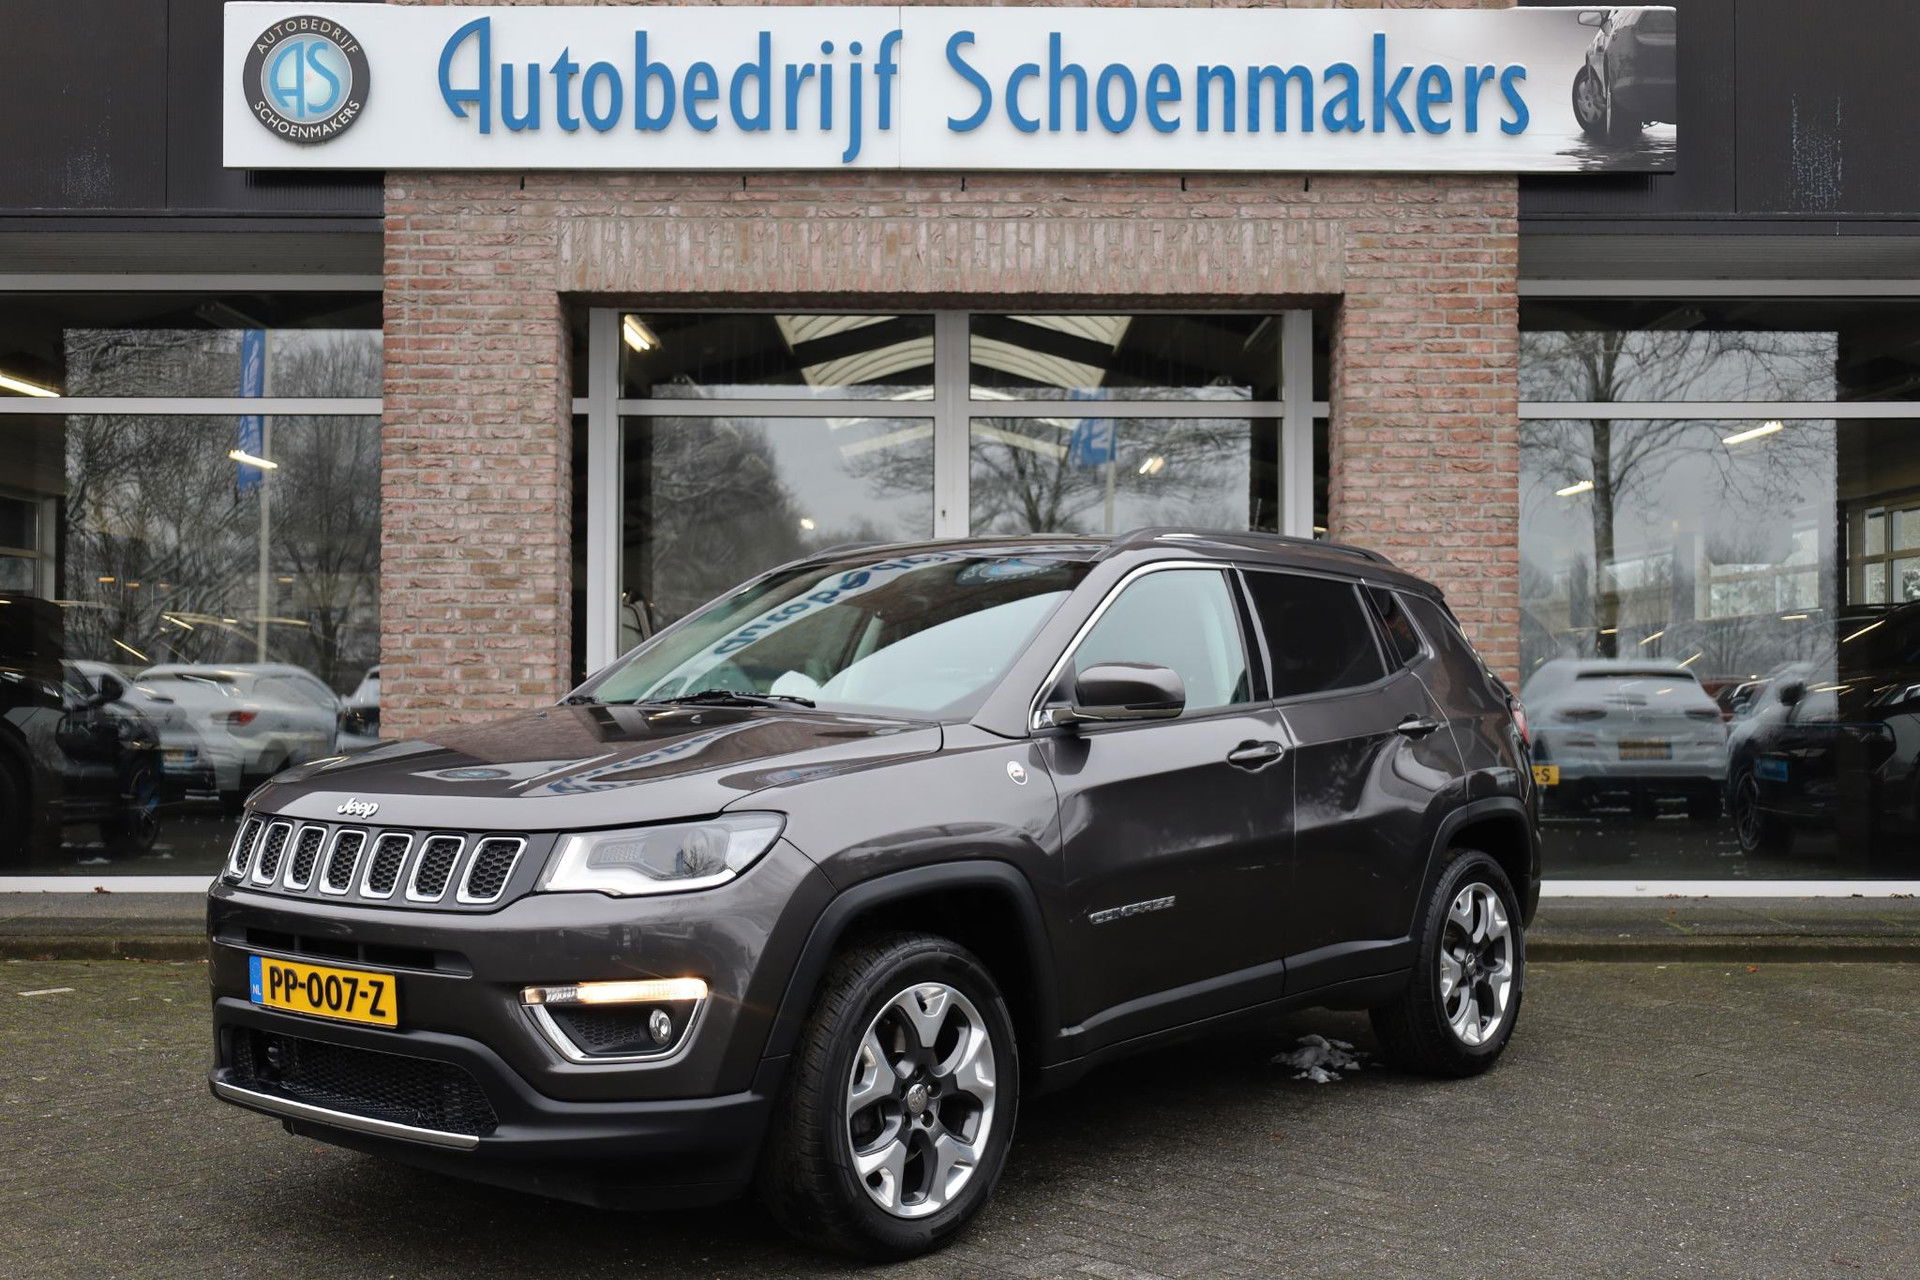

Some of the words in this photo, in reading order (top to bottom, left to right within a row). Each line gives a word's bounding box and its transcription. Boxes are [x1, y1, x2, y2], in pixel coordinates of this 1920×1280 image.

[255, 18, 360, 55] AUTOBEDRIJF
[269, 40, 341, 119] AS
[437, 15, 902, 165] Autobedrijf
[945, 30, 1531, 136] Schoenmakers
[253, 99, 361, 139] SCHOENMAKERS
[336, 797, 380, 820] Jeep
[251, 983, 262, 996] NL
[268, 965, 387, 1018] PP-007-Z
